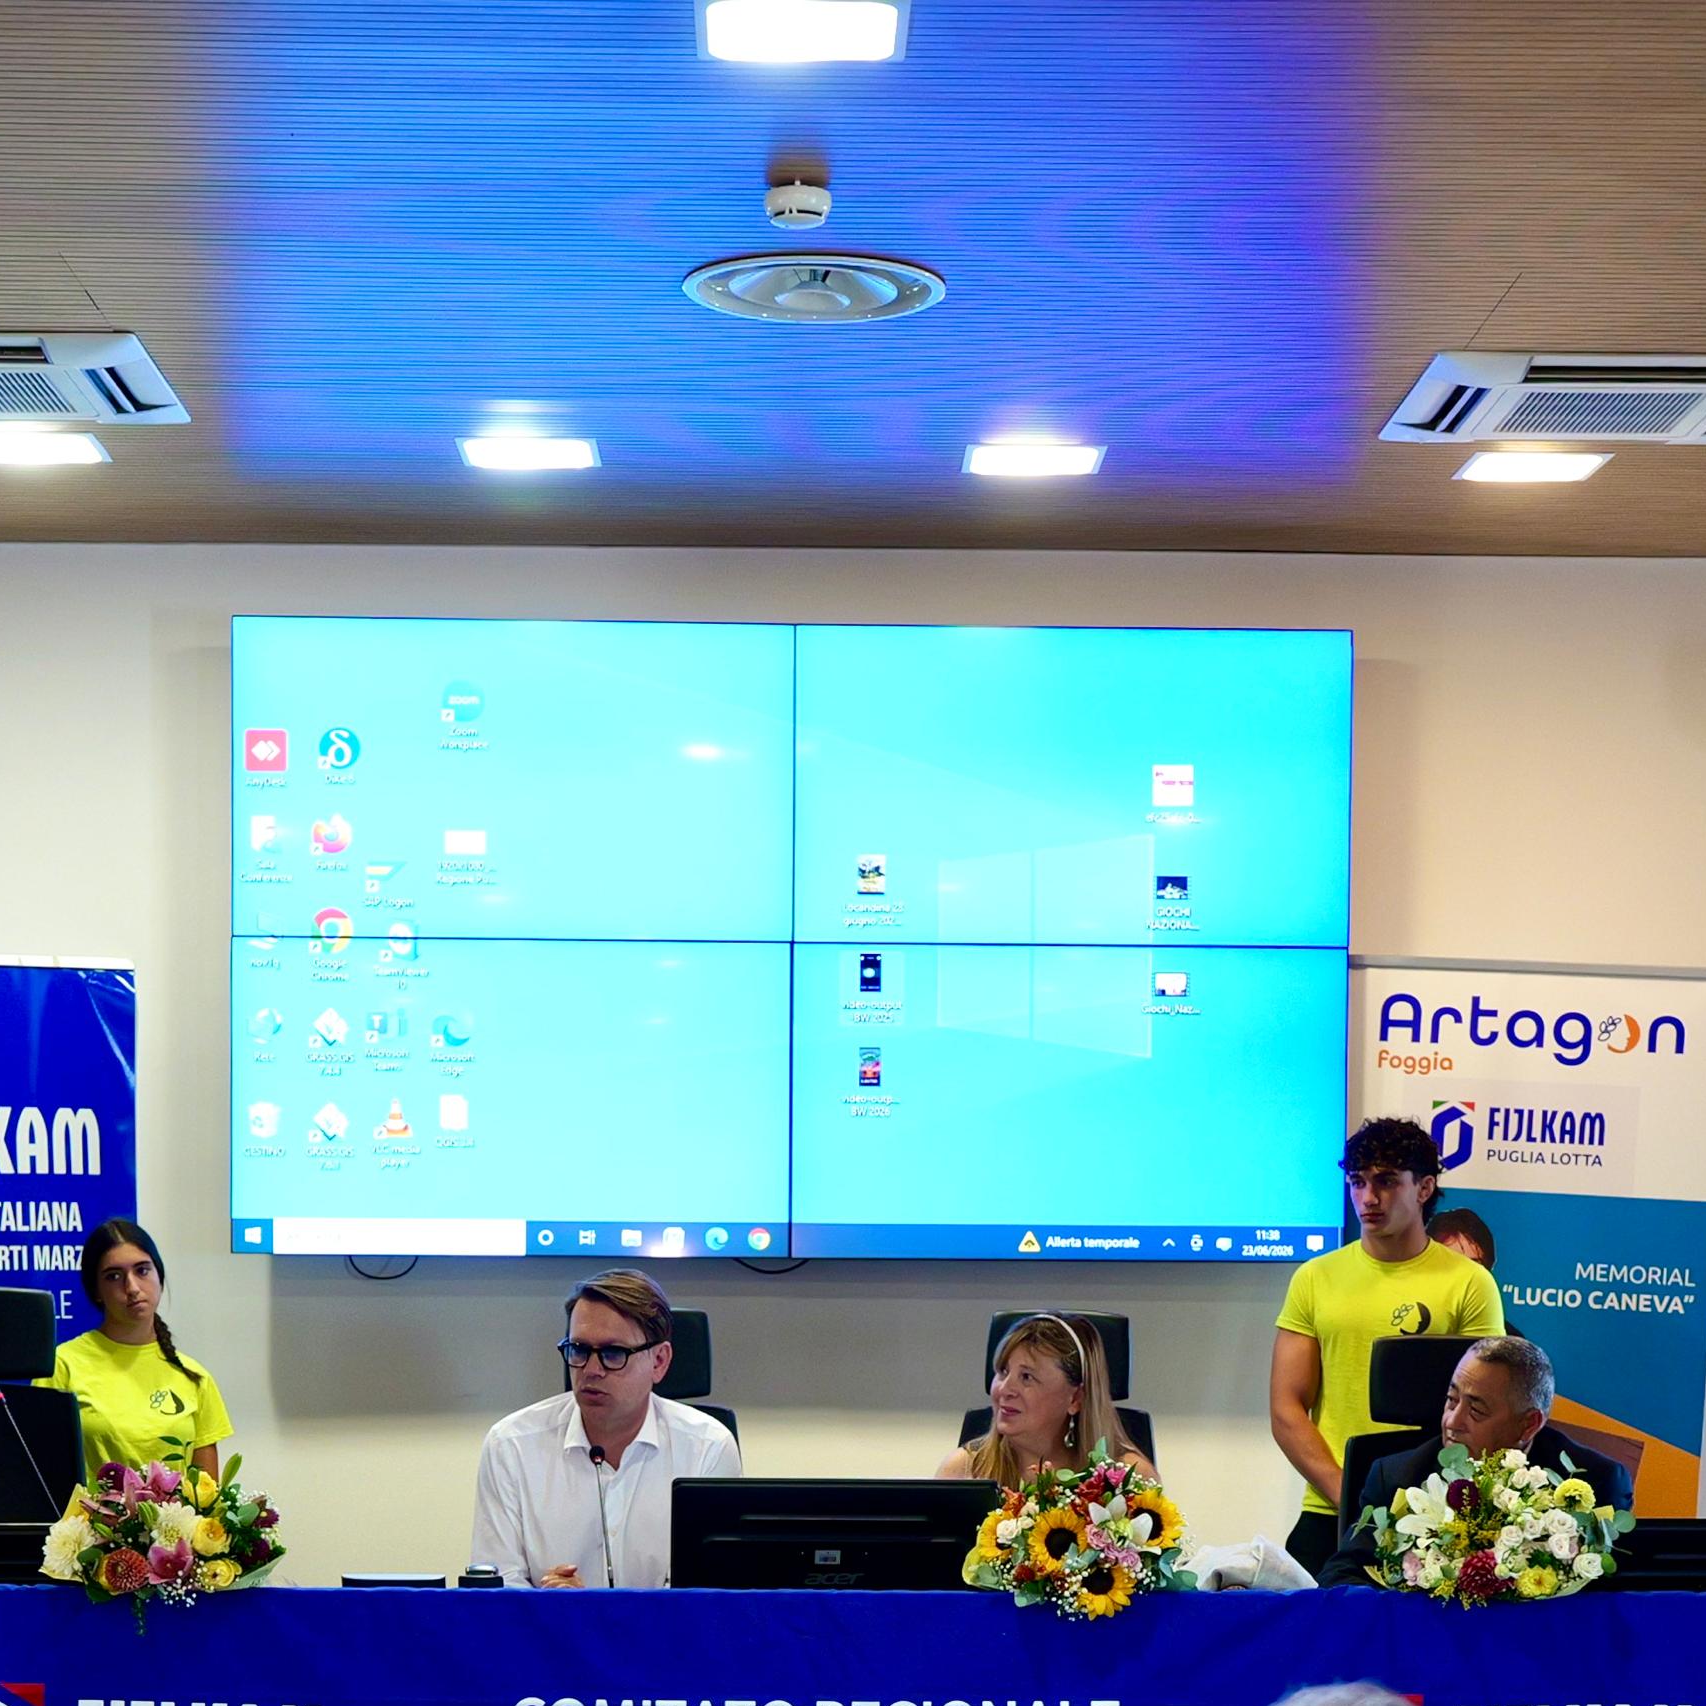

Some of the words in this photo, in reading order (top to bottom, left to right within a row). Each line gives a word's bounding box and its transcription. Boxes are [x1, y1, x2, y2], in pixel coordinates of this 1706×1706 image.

[1487, 1106, 1606, 1147] FIJLKAM
[1487, 1149, 1546, 1165] PUGLIA
[1550, 1151, 1603, 1168] LOTTA
[1045, 1235, 1083, 1249] Allerta
[1083, 1236, 1141, 1251] temporale
[1575, 1262, 1696, 1288] MEMORIAL
[804, 1573, 865, 1585] acer
